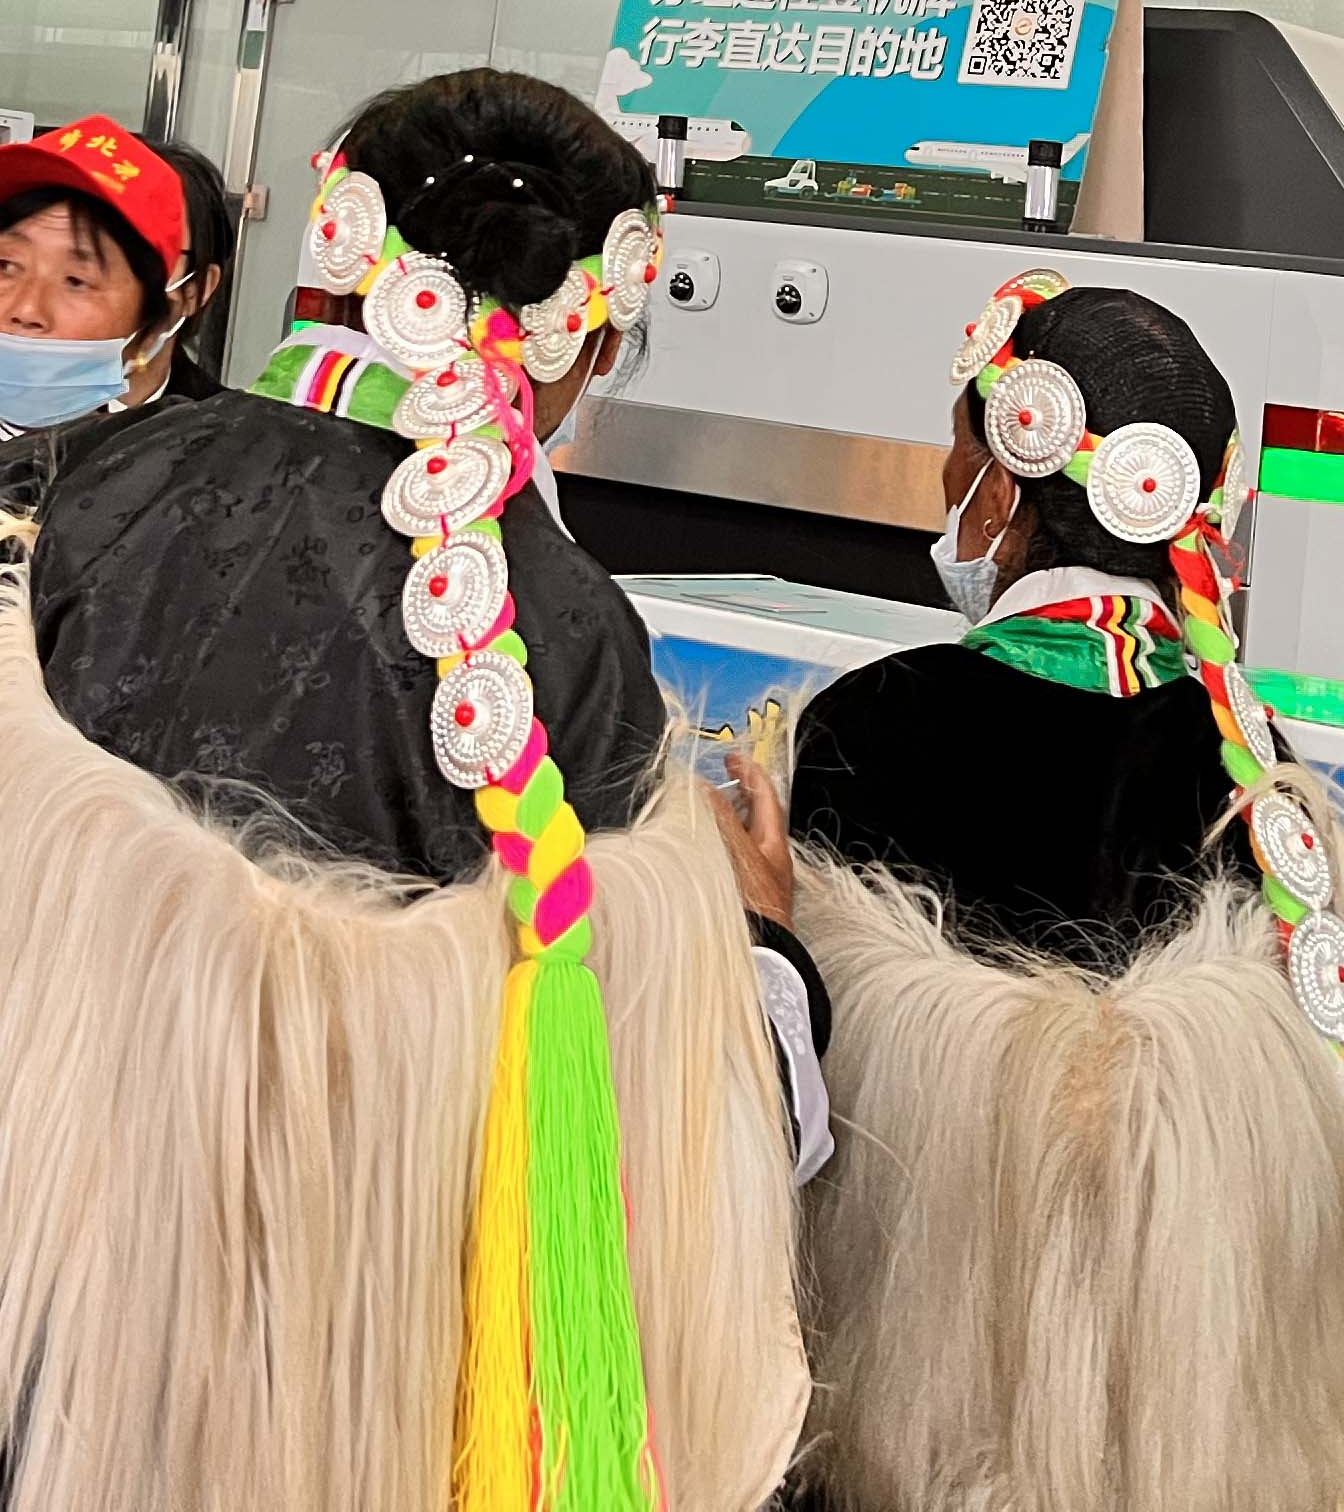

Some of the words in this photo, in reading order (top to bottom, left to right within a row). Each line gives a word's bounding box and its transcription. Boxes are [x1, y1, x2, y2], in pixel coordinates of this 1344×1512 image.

[639, 16, 951, 80] 行李直达目的地
